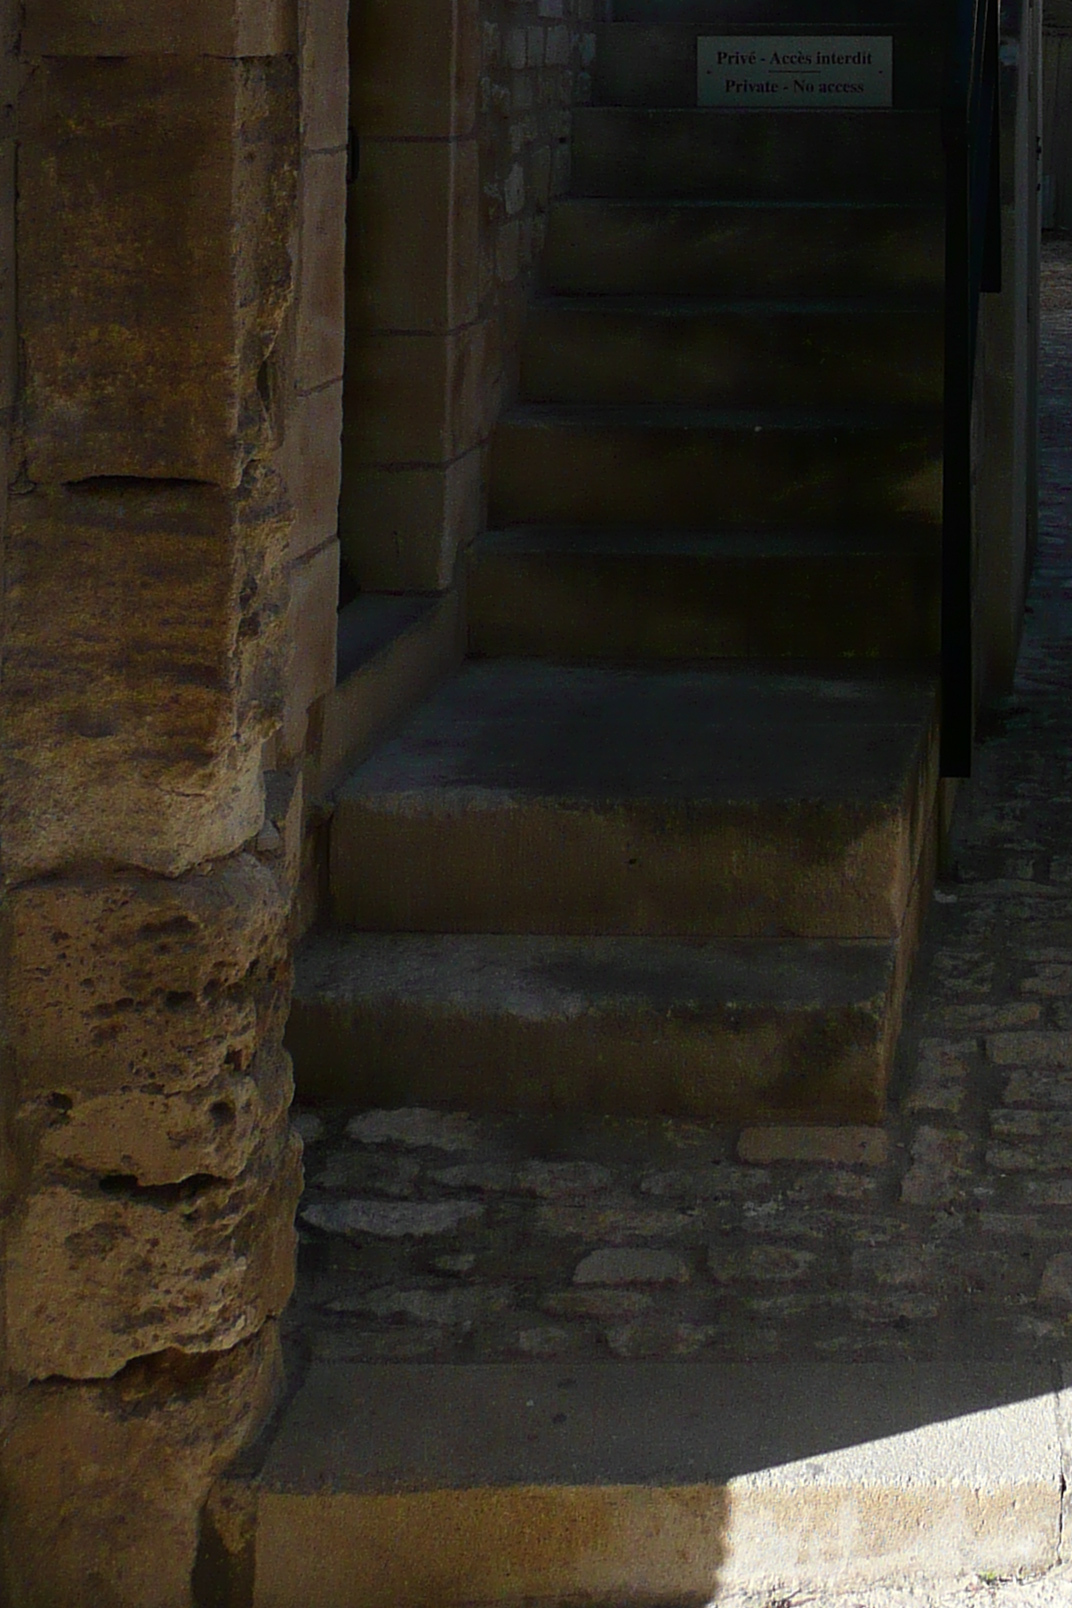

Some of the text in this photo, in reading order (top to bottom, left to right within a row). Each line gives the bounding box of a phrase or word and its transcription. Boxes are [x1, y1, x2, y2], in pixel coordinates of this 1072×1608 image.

[717, 51, 756, 65] Privé
[769, 51, 812, 65] Accès
[816, 51, 872, 65] interdit
[725, 79, 779, 93] Private
[793, 79, 814, 93] No
[818, 82, 864, 93] access
